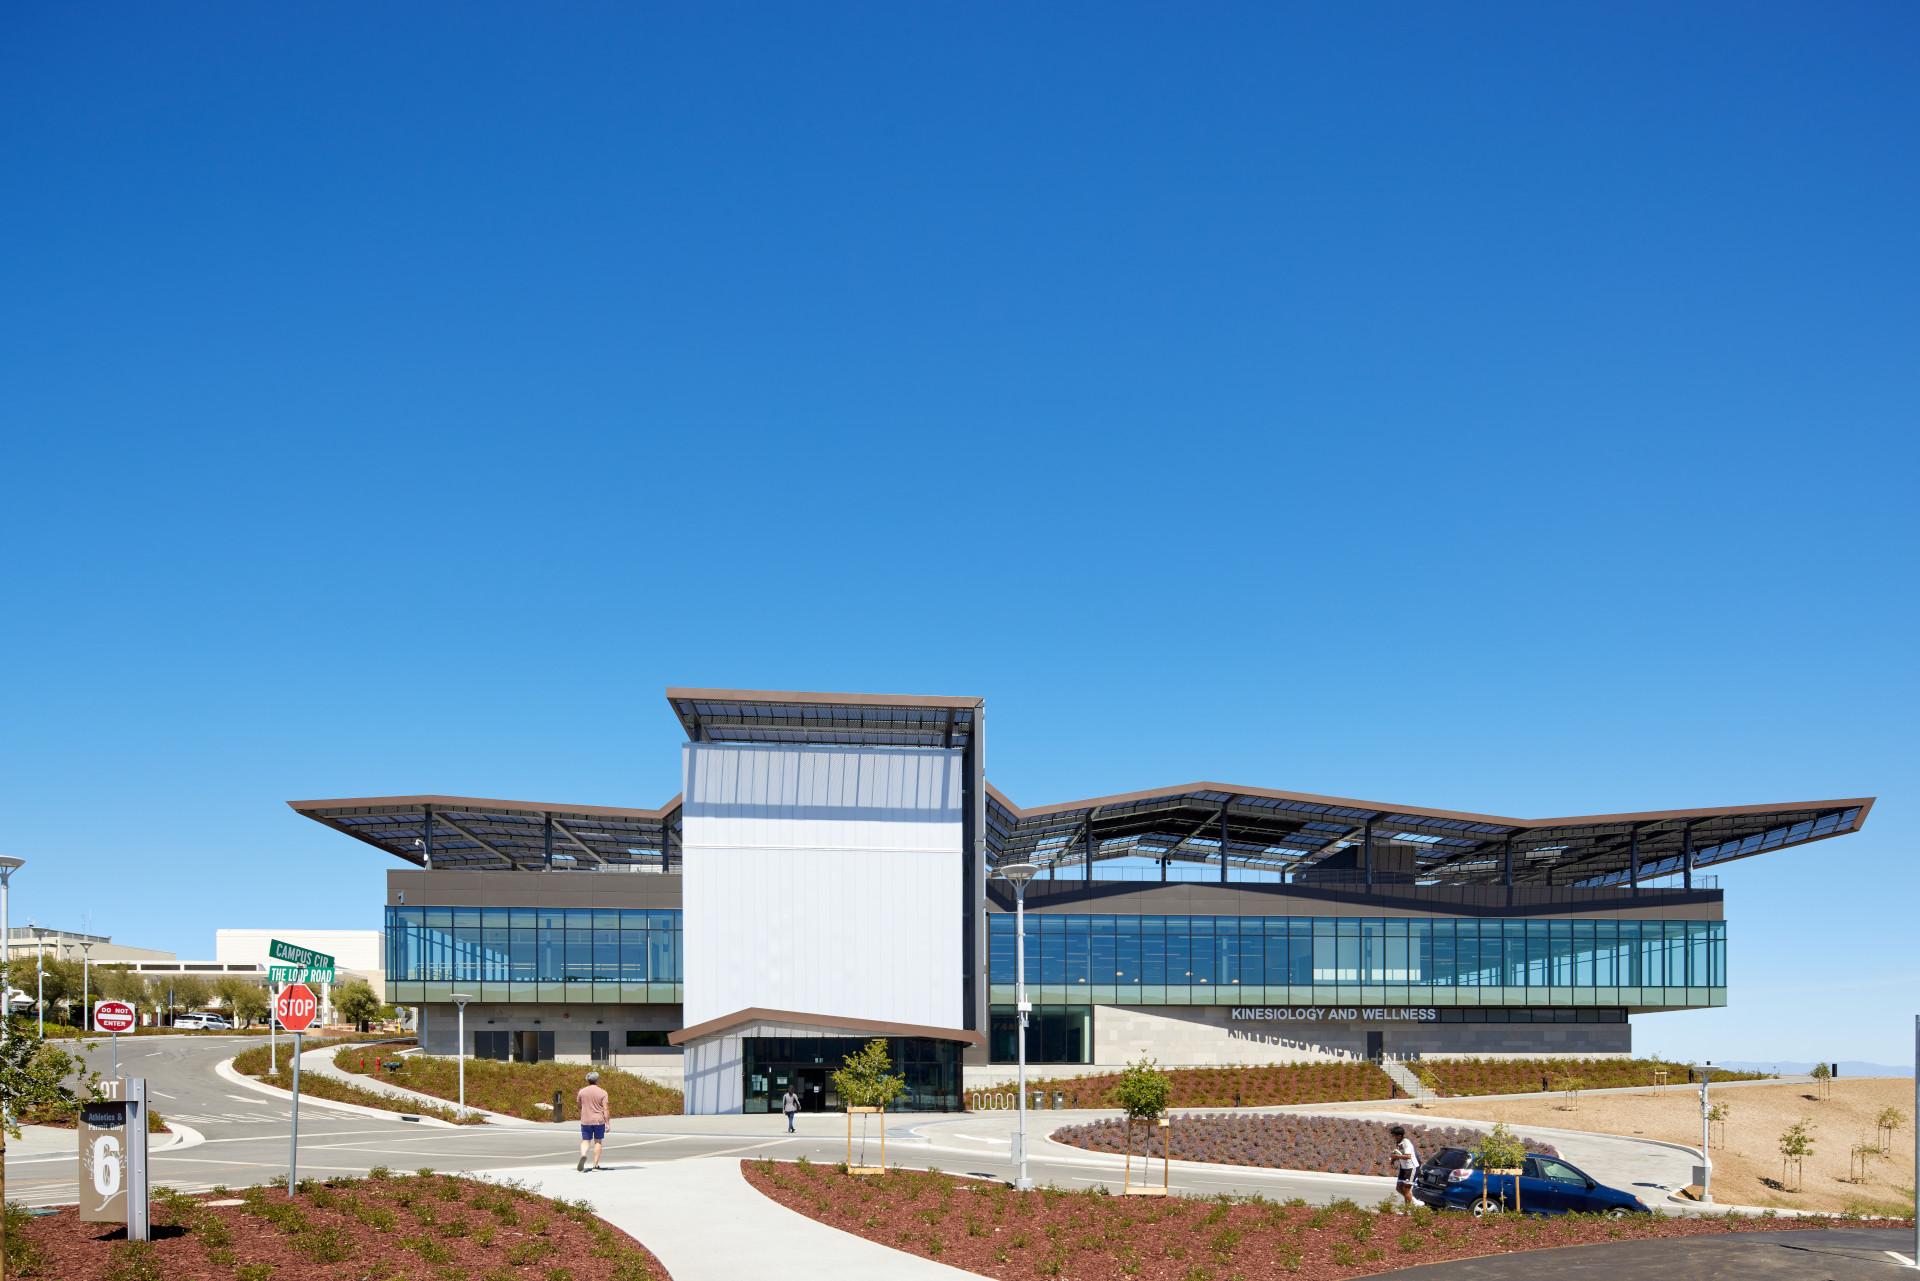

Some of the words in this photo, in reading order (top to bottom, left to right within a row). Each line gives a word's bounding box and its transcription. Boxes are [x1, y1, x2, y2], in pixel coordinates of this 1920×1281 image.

[276, 943, 312, 965] CAMPUS
[314, 954, 329, 968] CIR
[271, 968, 286, 981] THE
[310, 970, 332, 983] ROAD
[279, 998, 314, 1017] STOP
[1231, 1008, 1325, 1020] KINESIOLOGY
[1328, 1009, 1358, 1020] AND
[1362, 1009, 1436, 1020] WELLNESS
[88, 1112, 115, 1121] Athletics
[88, 1123, 108, 1131] Permit
[110, 1122, 124, 1133] Only
[93, 1135, 120, 1196] 6
